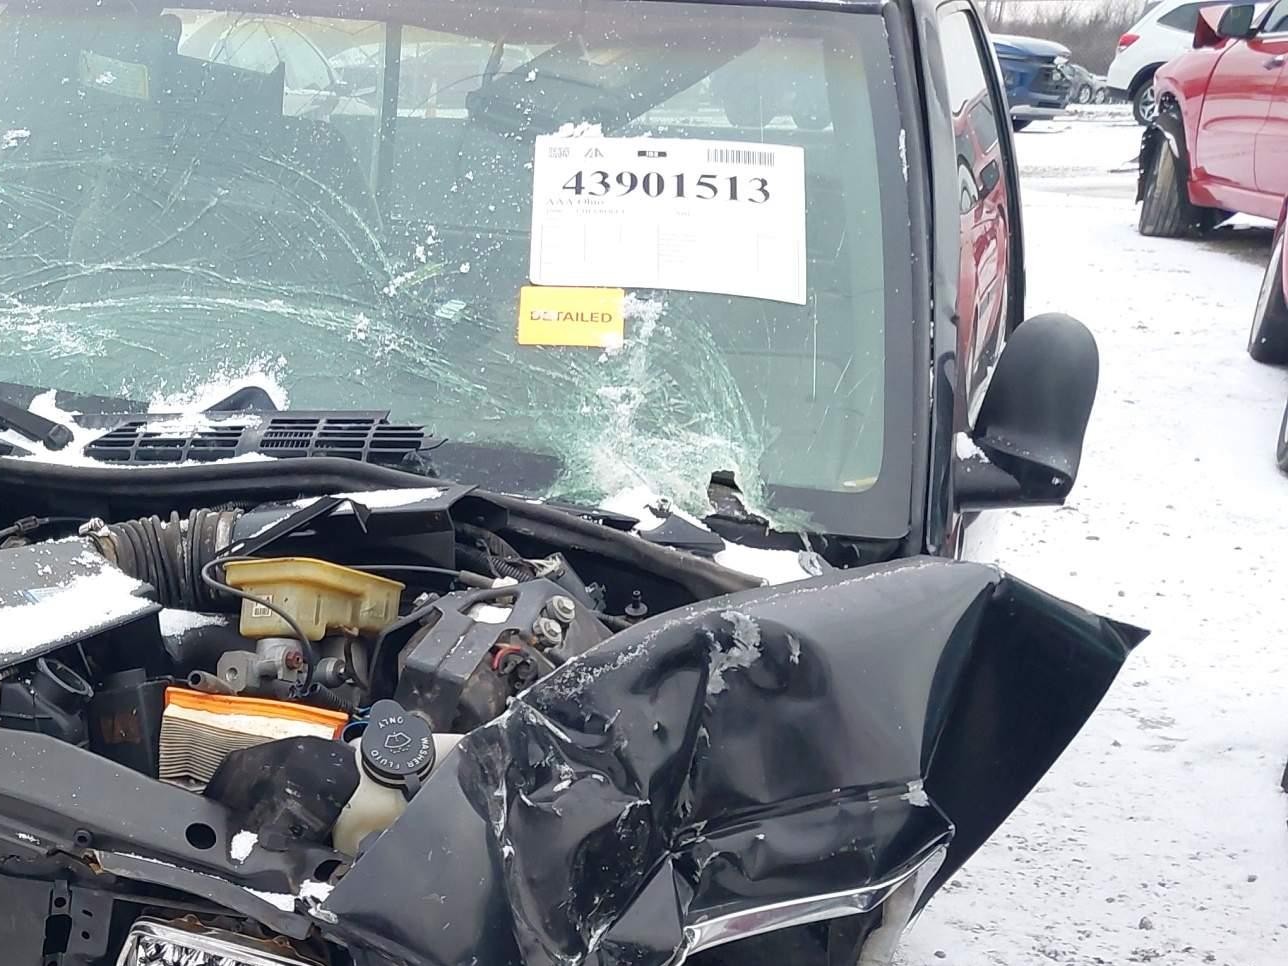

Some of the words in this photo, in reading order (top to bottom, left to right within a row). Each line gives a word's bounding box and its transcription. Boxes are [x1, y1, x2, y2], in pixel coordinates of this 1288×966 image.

[562, 170, 771, 204] 43901513
[378, 716, 403, 728] ONLY
[371, 750, 400, 769] FLUID
[407, 737, 429, 767] WASHER
